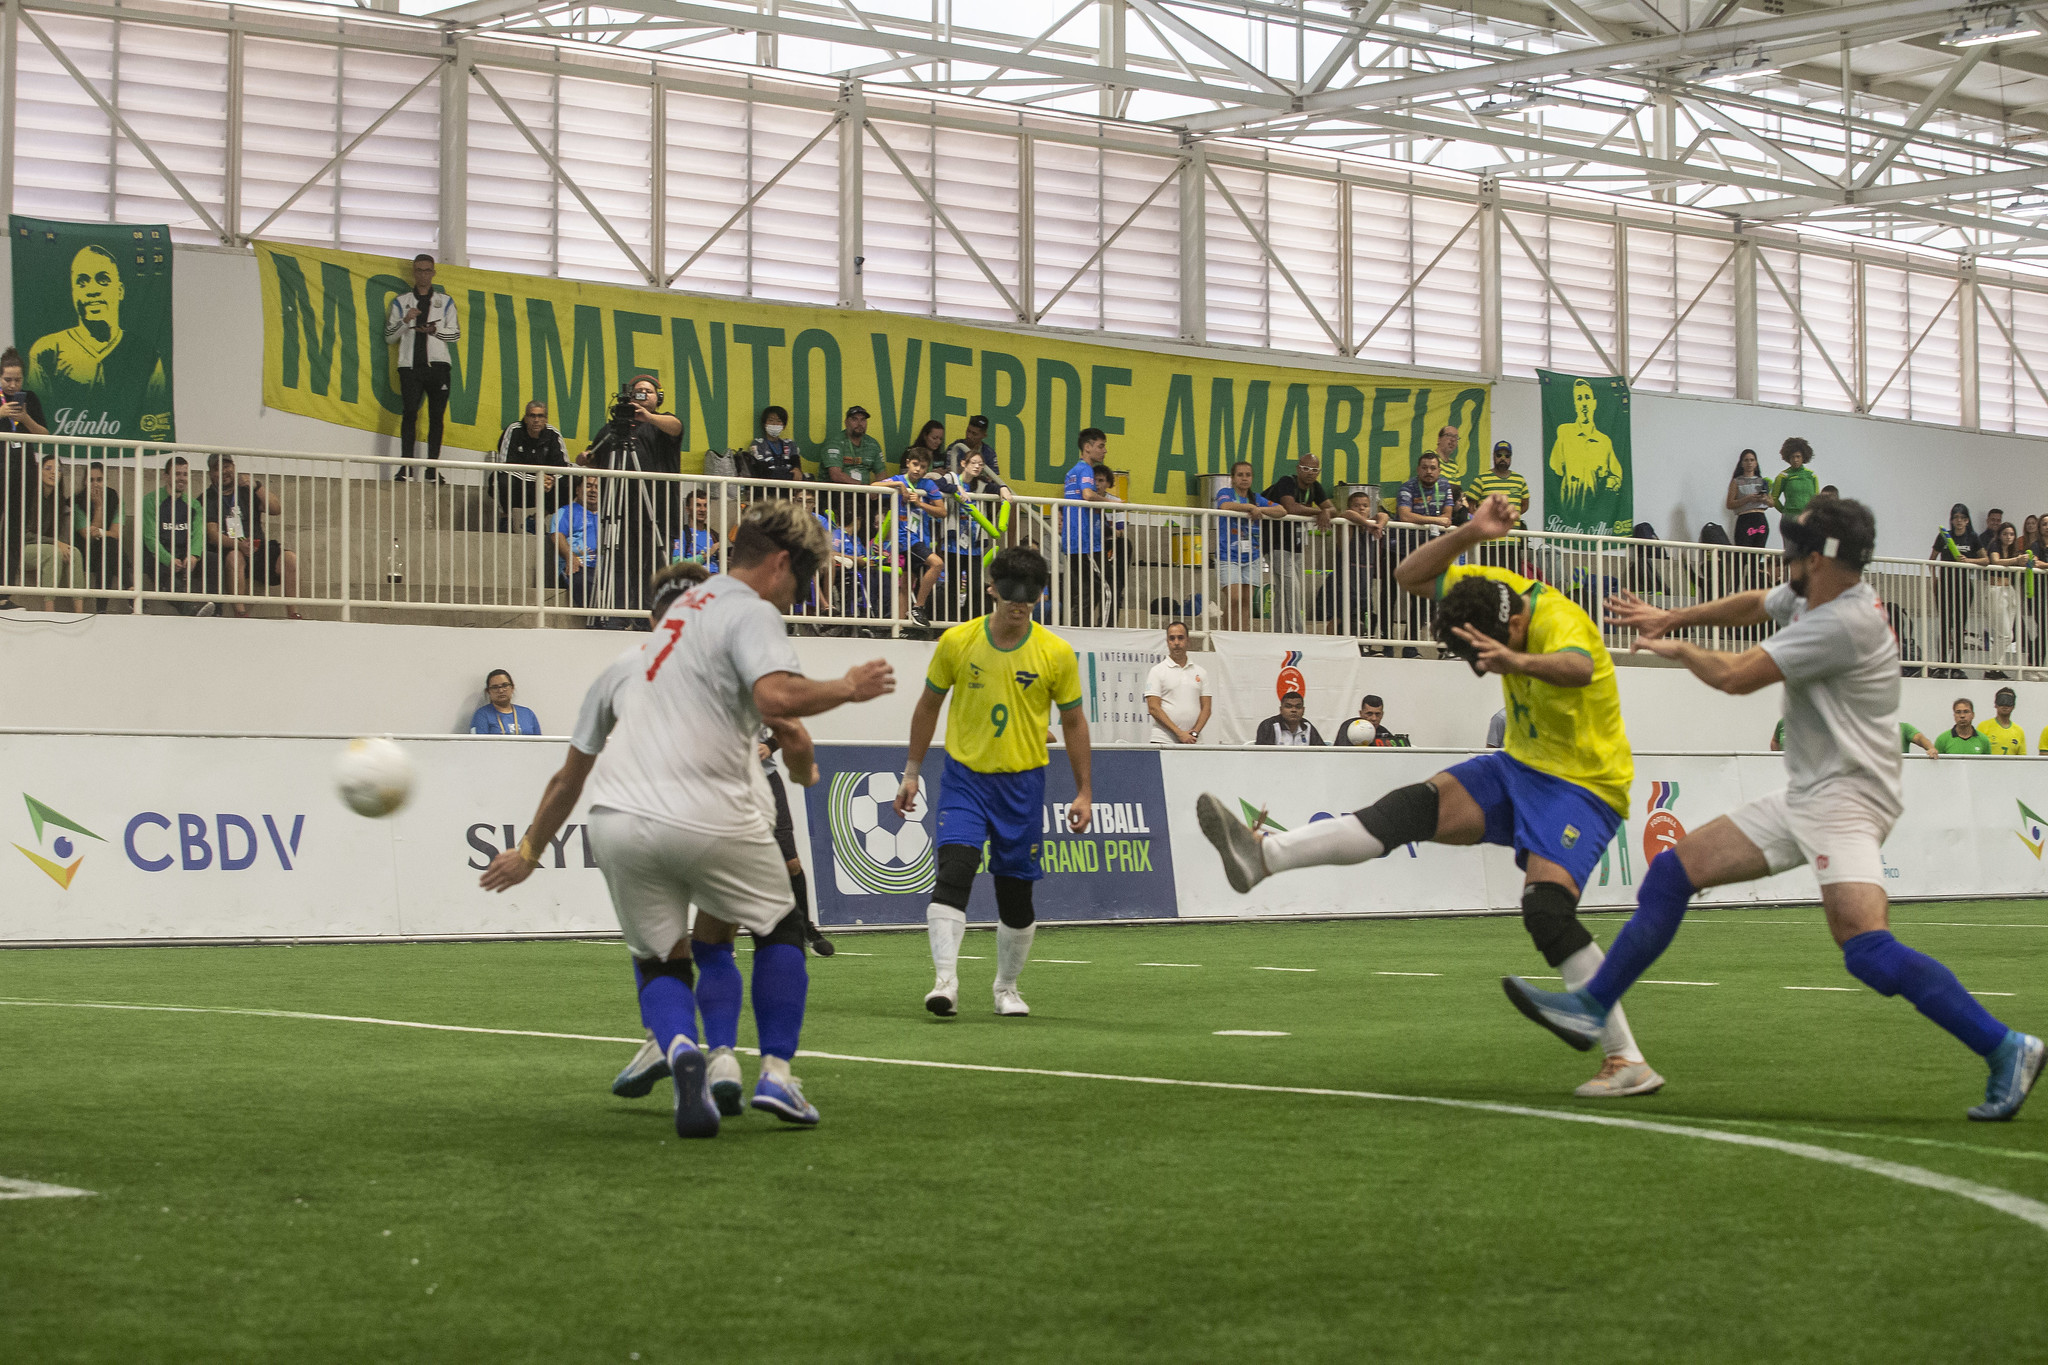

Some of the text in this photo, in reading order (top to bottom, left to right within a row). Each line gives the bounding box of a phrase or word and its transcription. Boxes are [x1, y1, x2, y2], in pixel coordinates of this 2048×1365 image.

[151, 231, 160, 239] 12
[136, 254, 163, 264] 16 20
[269, 250, 1486, 499] MOVIMENTO VERDE AMARELO
[54, 408, 120, 436] Jefinho
[645, 619, 685, 682] 7
[991, 703, 1008, 738] 9
[1053, 803, 1150, 833] FOTBALL
[1650, 815, 1677, 828] FOOTBALL
[124, 812, 305, 872] CBDV
[1040, 840, 1153, 873] RAND PRIX
